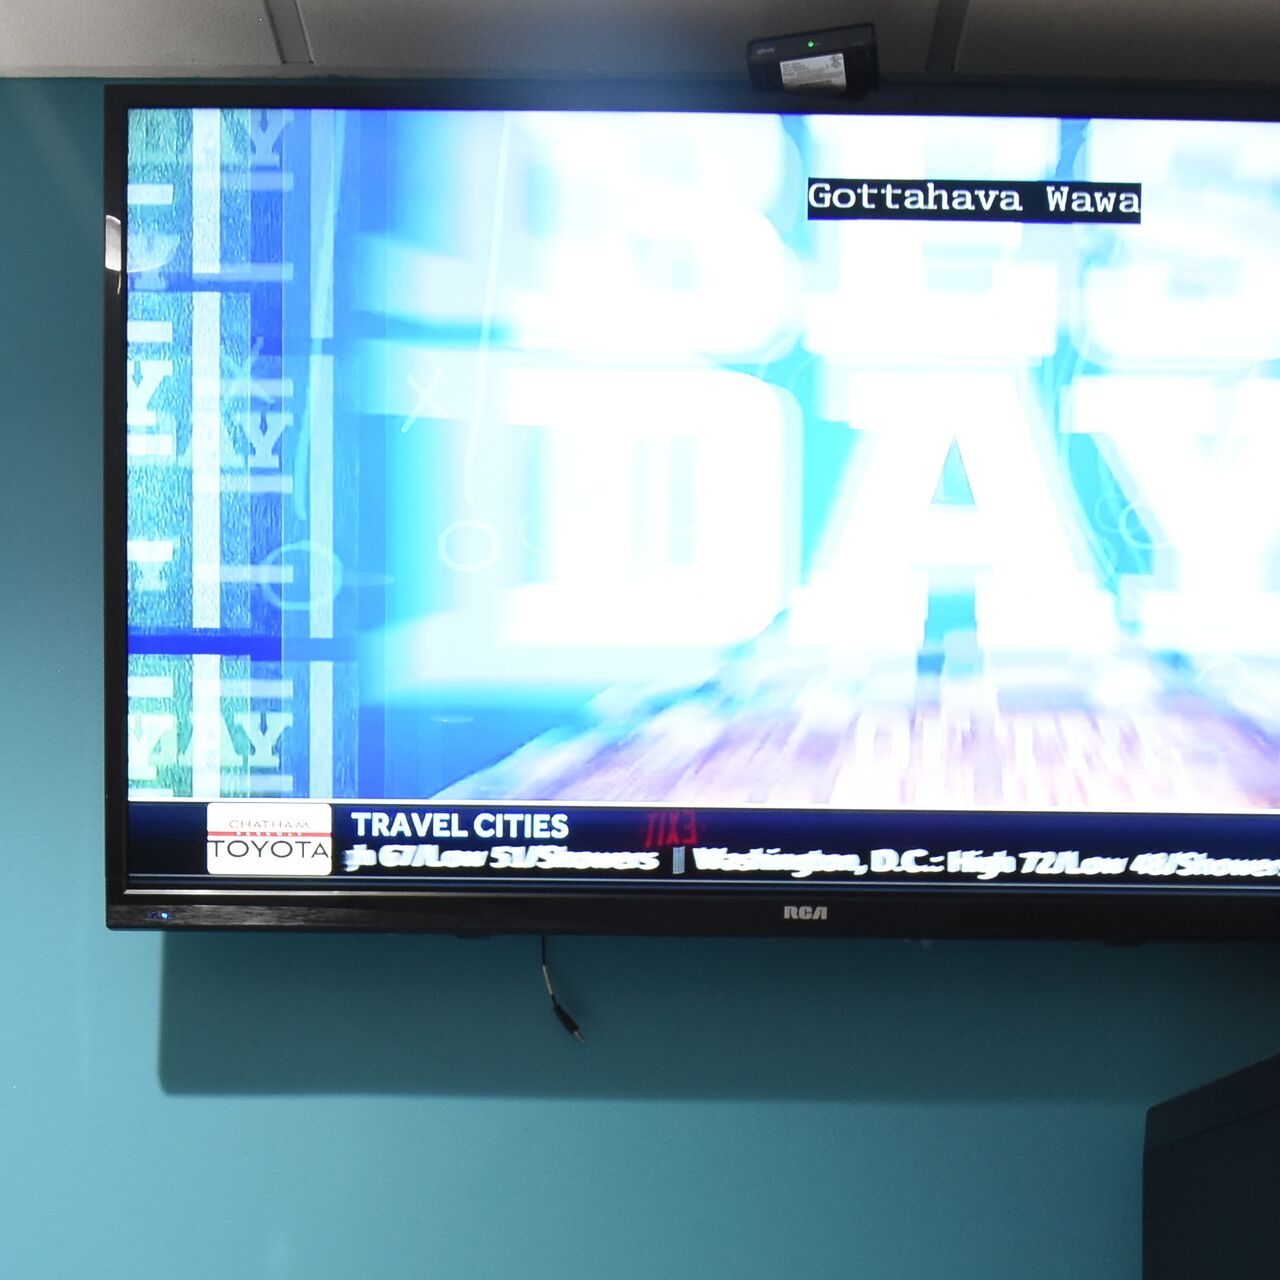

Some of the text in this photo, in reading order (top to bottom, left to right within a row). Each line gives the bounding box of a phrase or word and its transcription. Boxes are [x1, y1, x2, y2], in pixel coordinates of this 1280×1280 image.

[807, 182, 1141, 214] Gottahava Wawa
[228, 819, 310, 829] CHATHAM
[350, 811, 570, 839] TRAVEL CITIES
[207, 839, 330, 858] TOYOTA
[783, 905, 828, 920] RCA
